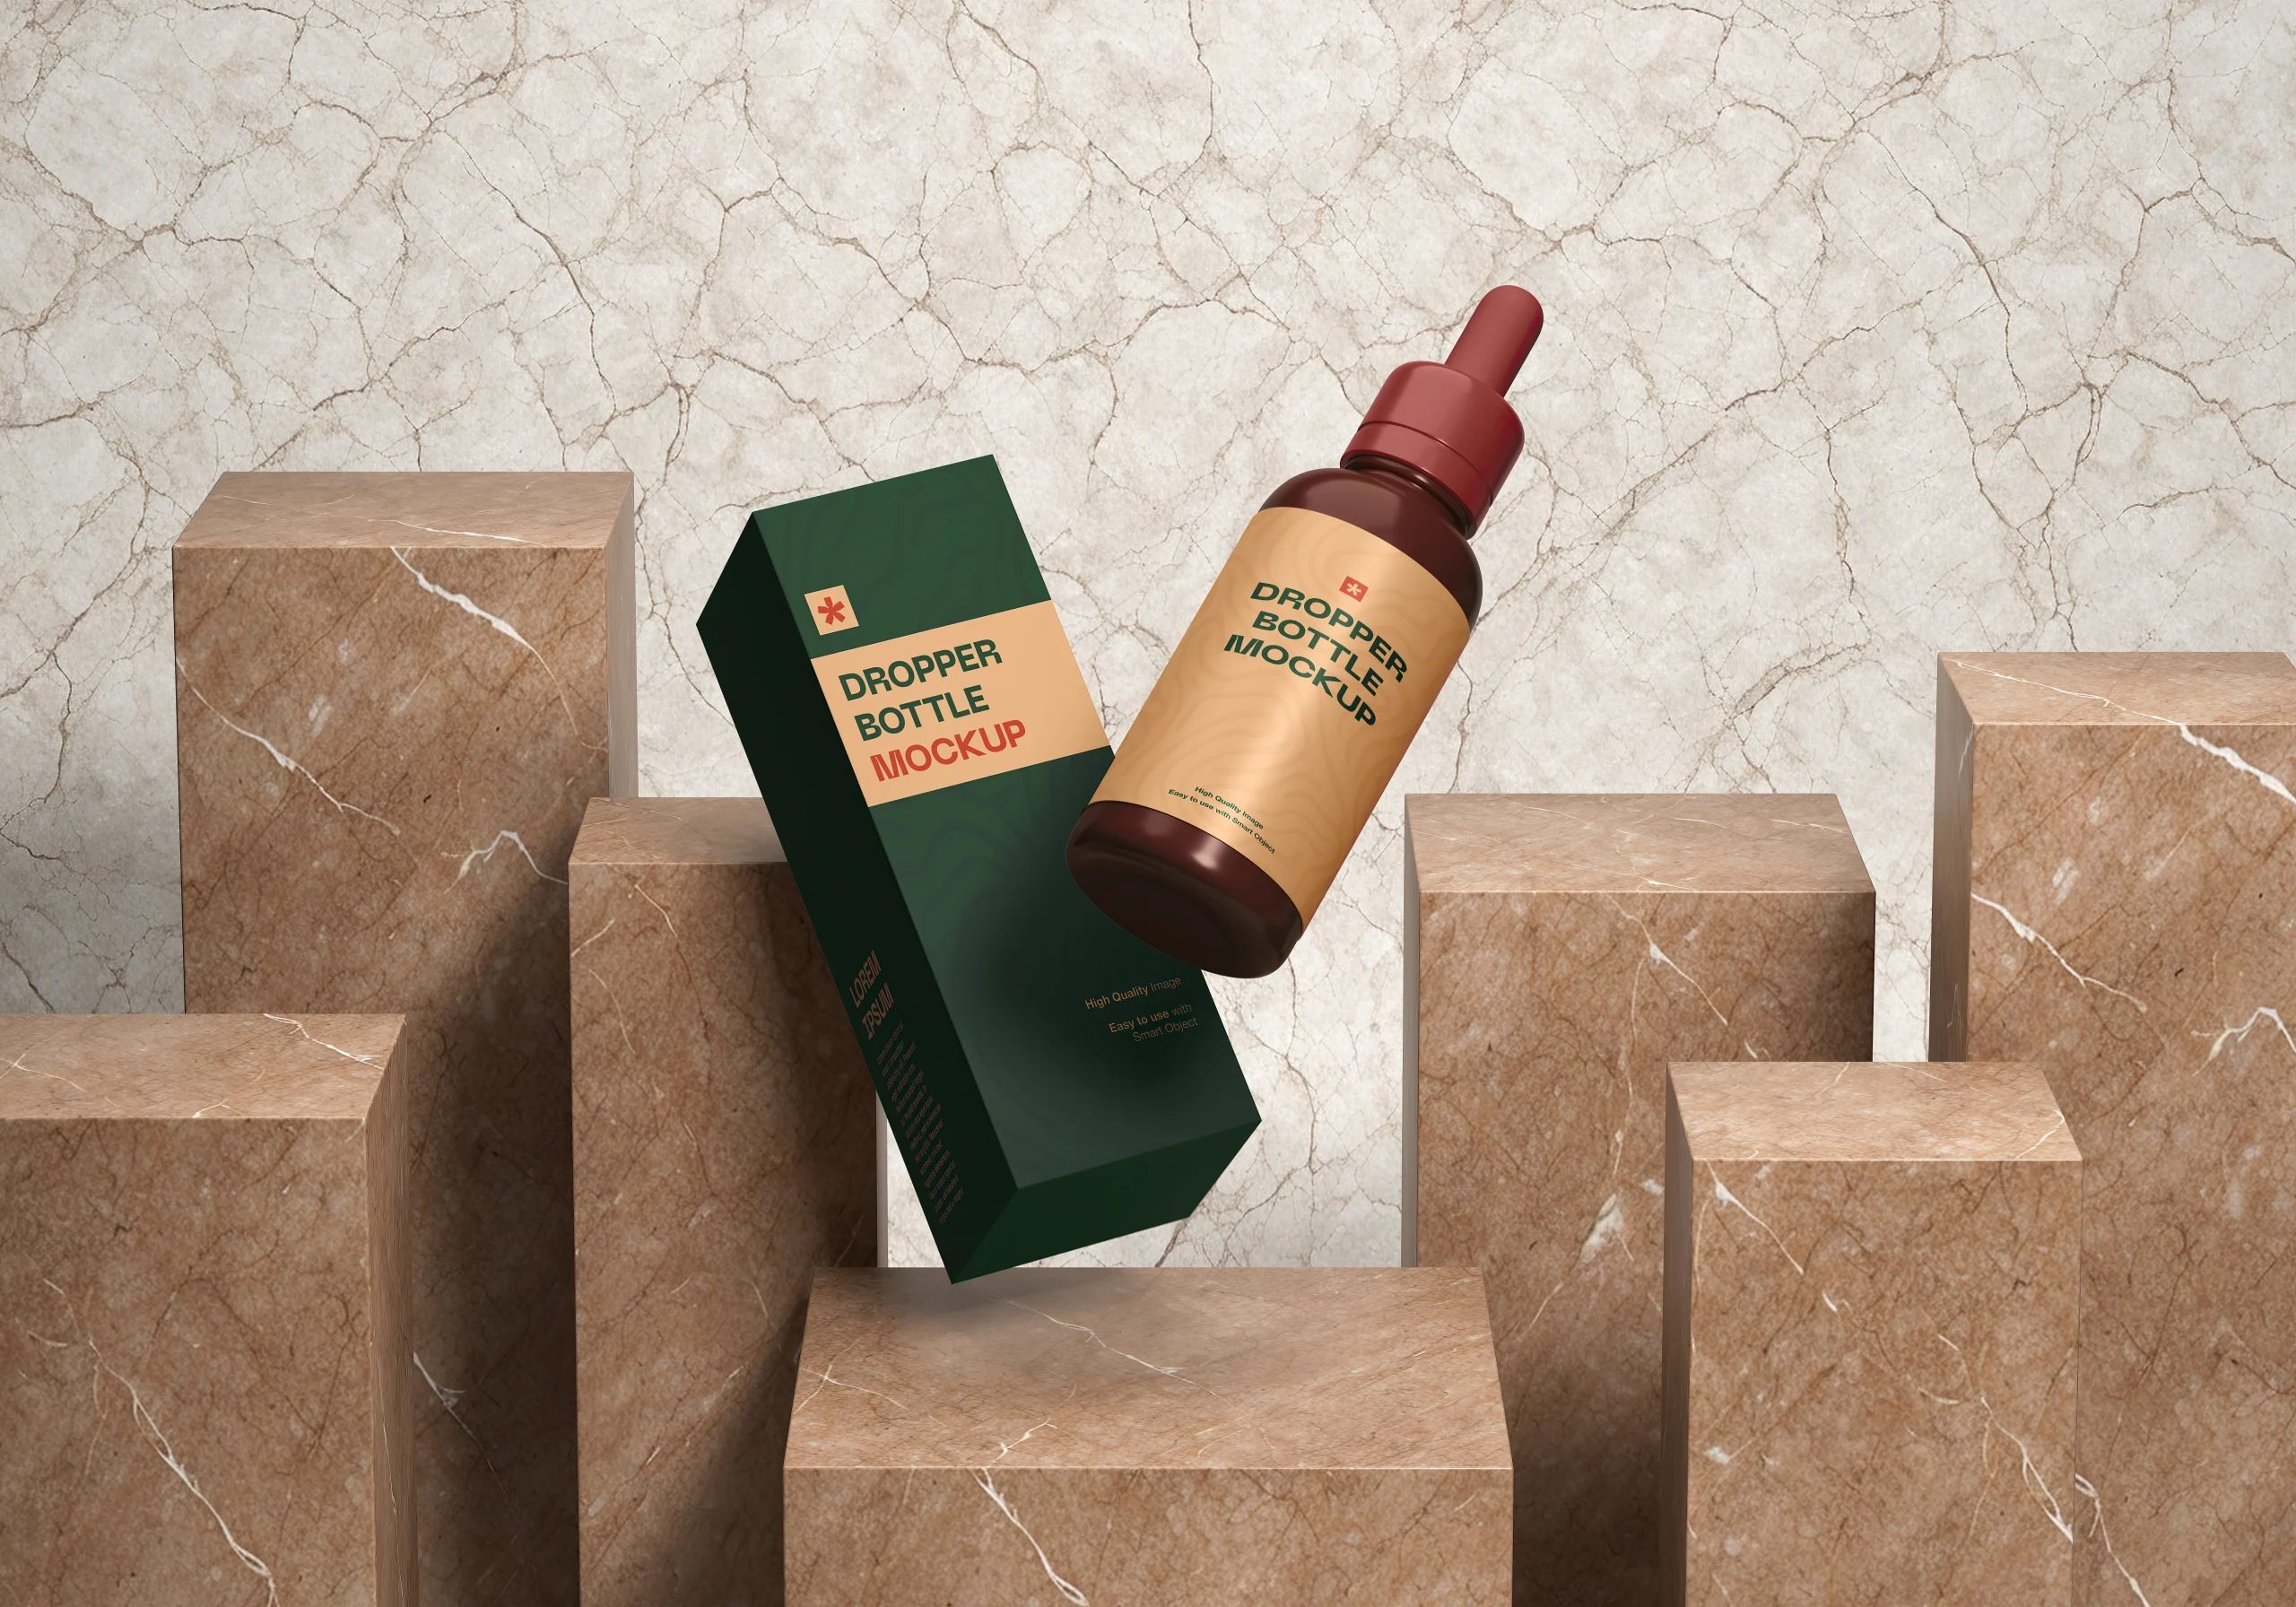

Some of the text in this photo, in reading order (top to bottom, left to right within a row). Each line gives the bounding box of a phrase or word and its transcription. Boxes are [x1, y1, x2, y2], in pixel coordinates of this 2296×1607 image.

[1250, 581, 1407, 683] DROPPER
[1251, 610, 1384, 697] BOTTLE
[838, 638, 1003, 701] DROPPER
[1223, 633, 1377, 726] MOCKUP
[854, 684, 990, 742] BOTTLE
[869, 719, 1026, 782] MOCKUP
[1168, 788, 1188, 800] Easy
[1199, 801, 1214, 810] use
[1215, 807, 1231, 820] with
[1231, 817, 1253, 835] Smart
[1254, 832, 1275, 855] Object
[1195, 786, 1264, 830] High Quality Image
[849, 950, 882, 1008] LOREM
[1084, 977, 1182, 1010] High Quality Image
[861, 982, 894, 1040] IPSUM
[1109, 1003, 1193, 1033] Easy to use with
[1133, 1017, 1199, 1042] Smart Object
